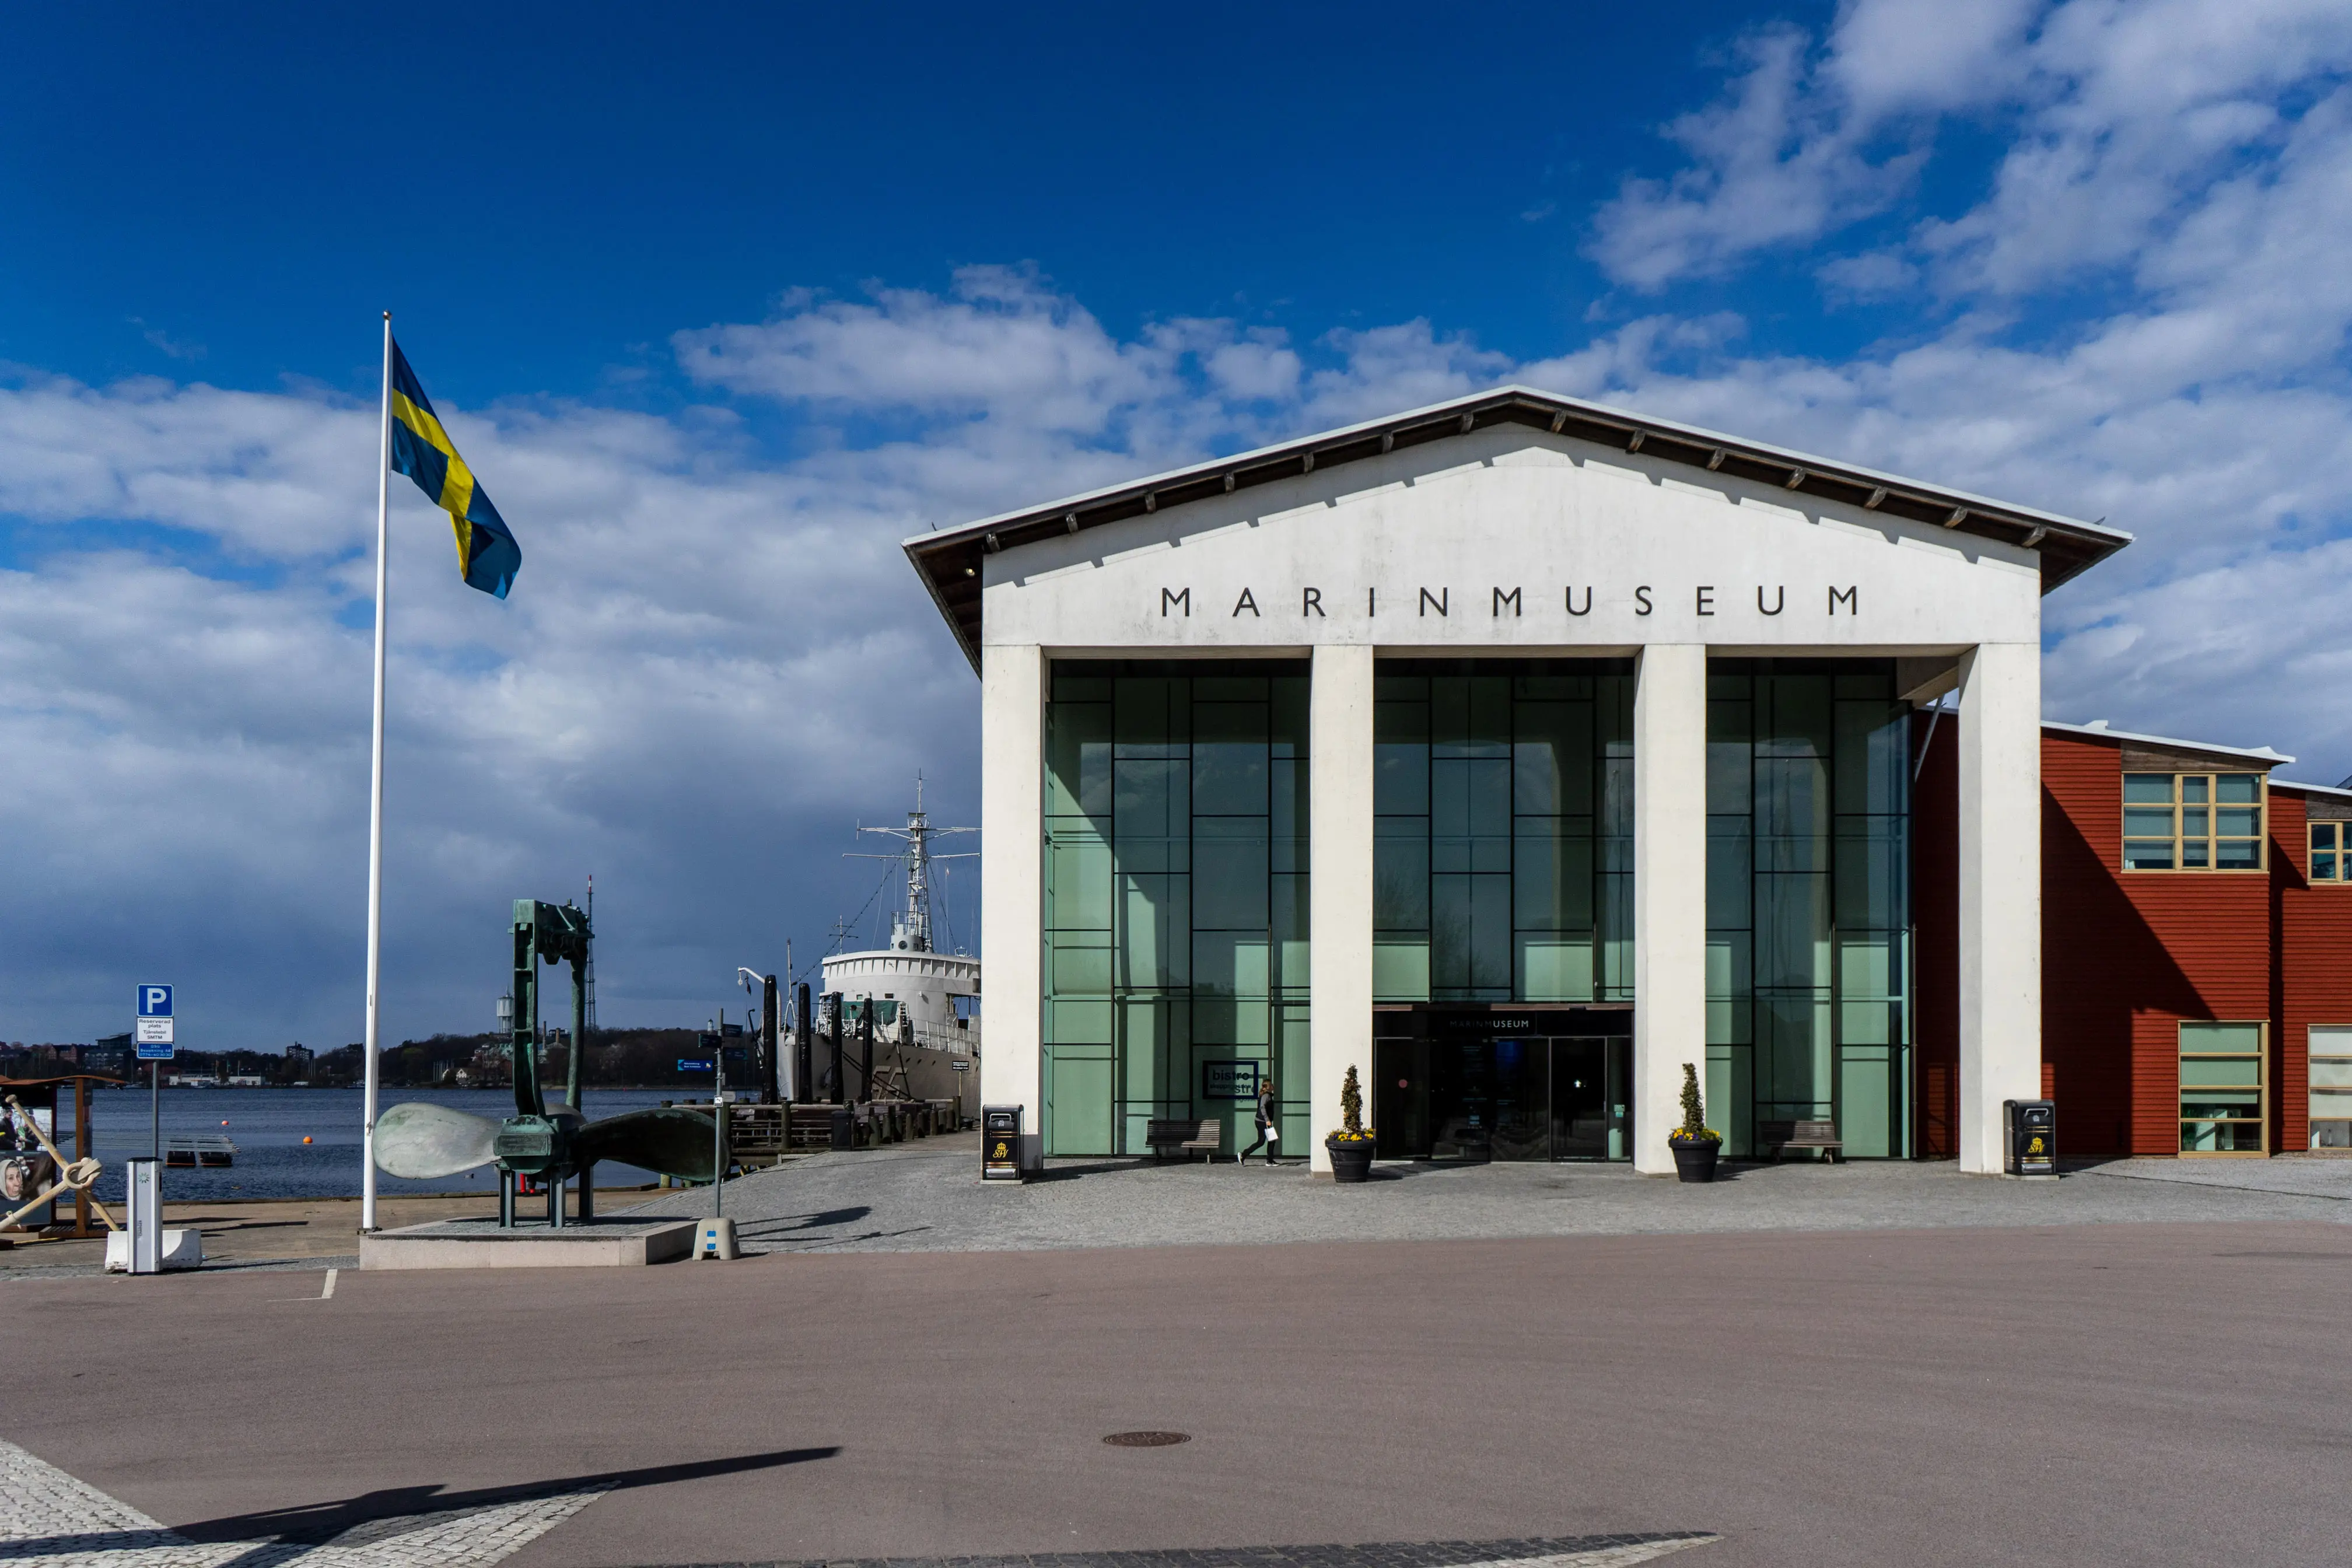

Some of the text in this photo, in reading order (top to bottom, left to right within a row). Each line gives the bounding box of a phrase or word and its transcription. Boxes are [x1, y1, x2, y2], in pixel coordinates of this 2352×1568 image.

[1161, 585, 1857, 617] MARINMUSEUM
[147, 988, 167, 1013] P
[1450, 1020, 1529, 1028] MARINMUSEUM
[1213, 1069, 1250, 1081] bistro
